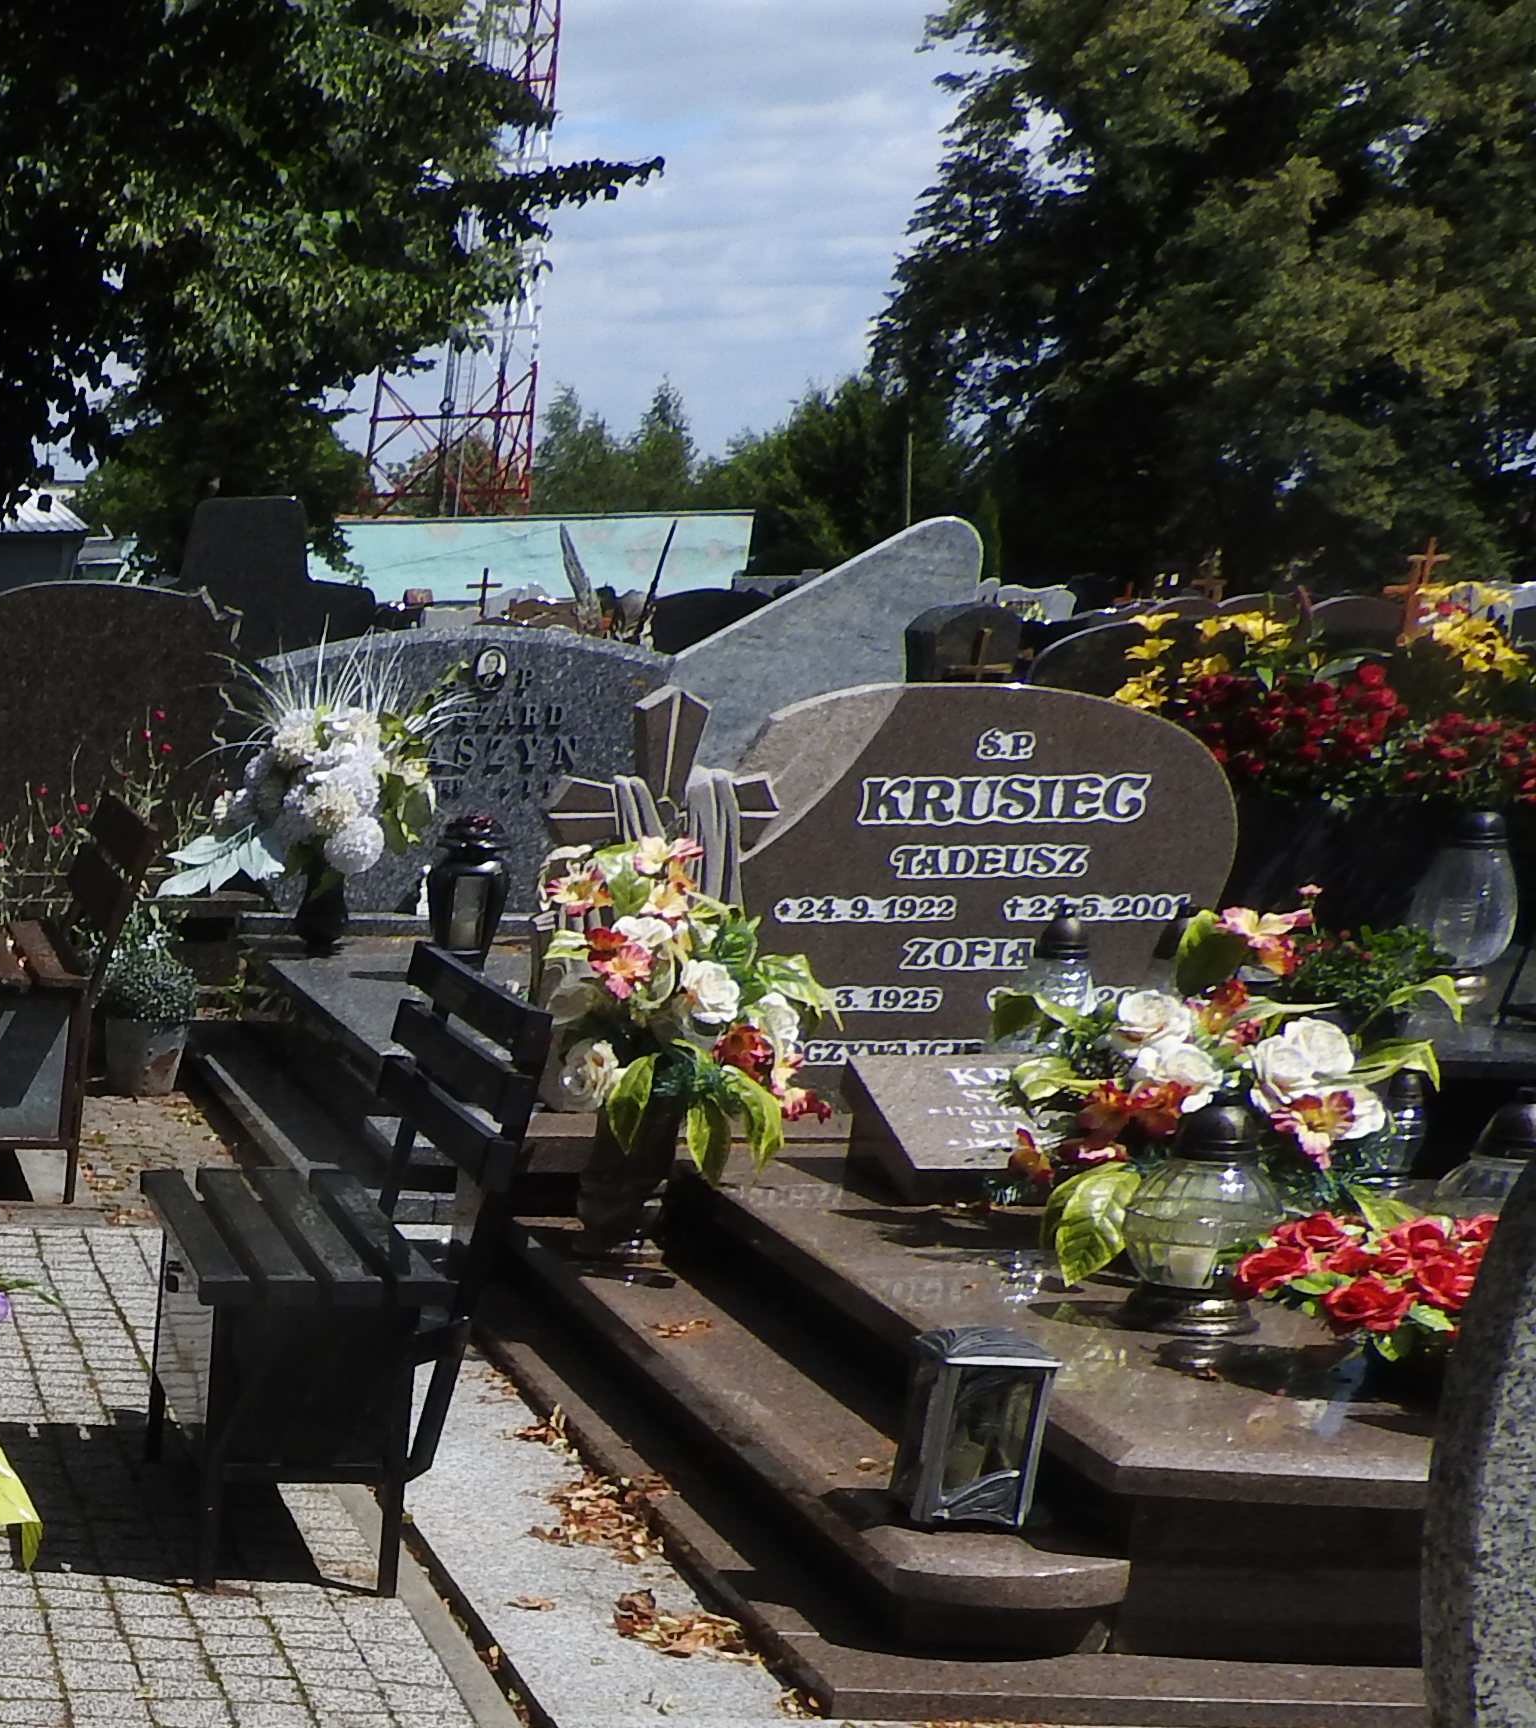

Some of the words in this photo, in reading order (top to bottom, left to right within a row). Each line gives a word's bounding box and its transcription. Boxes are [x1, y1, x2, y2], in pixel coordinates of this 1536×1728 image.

[457, 703, 567, 726] SZARD
[427, 735, 580, 766] ASZYN
[893, 846, 1089, 877] TADEUSZ
[881, 897, 956, 919] 1922
[903, 939, 1033, 968] ZOFIA
[867, 988, 943, 1010] 1925
